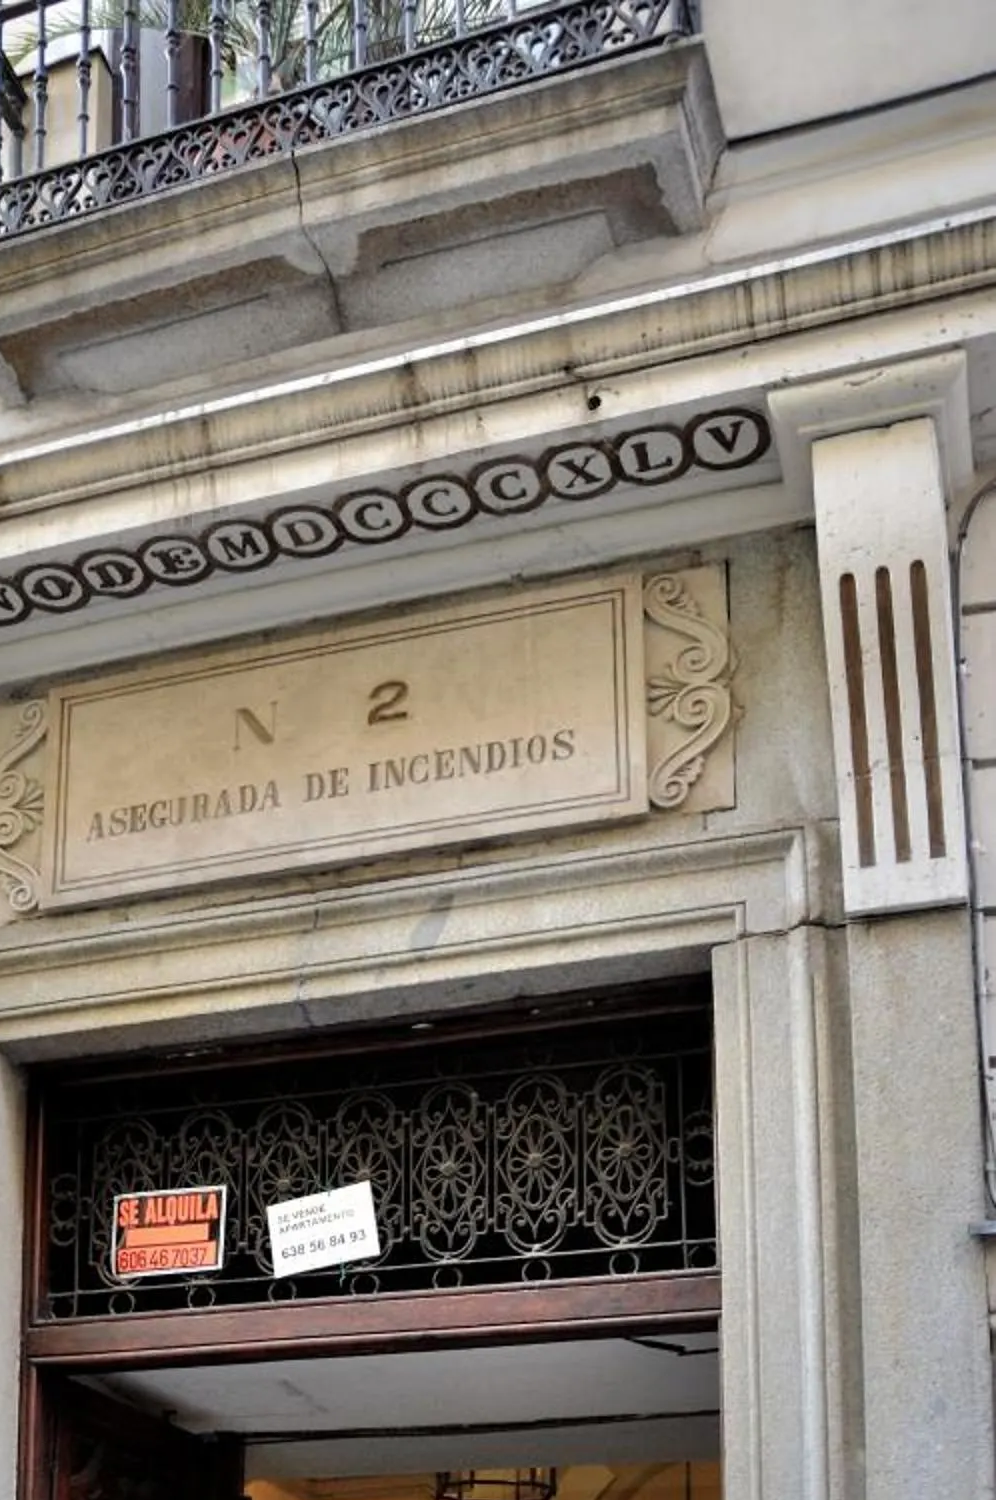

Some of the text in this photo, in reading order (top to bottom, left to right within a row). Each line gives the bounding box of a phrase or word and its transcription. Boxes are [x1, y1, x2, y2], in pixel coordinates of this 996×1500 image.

[87, 547, 202, 588] DE
[218, 420, 745, 562] MDCCCXLV
[233, 680, 410, 752] N 2
[86, 728, 577, 843] ASEGURADA DE INCENDIOS
[119, 1193, 218, 1227] SE ALQUILA
[281, 1244, 305, 1259] 638
[349, 1229, 366, 1243] 93
